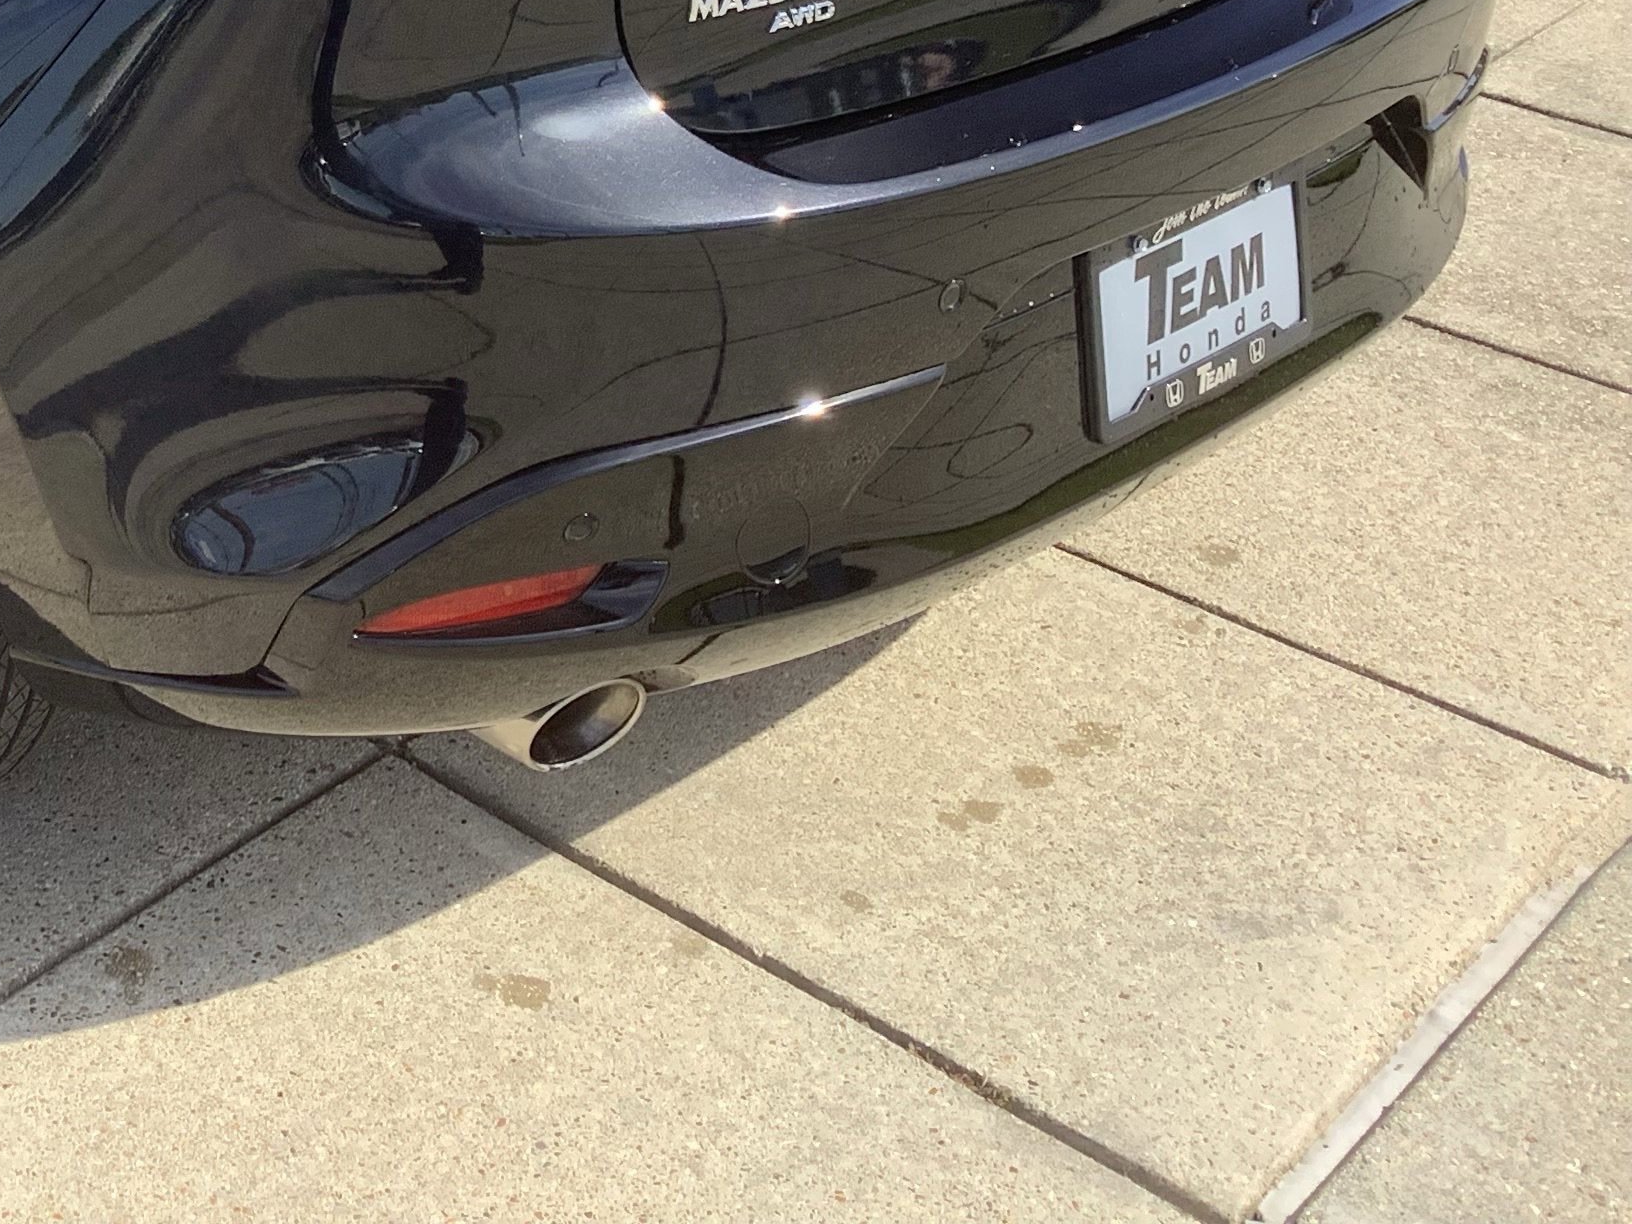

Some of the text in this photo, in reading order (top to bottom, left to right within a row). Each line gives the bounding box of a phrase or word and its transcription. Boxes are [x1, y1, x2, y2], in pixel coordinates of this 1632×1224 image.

[769, 0, 836, 33] AWD
[1134, 232, 1265, 346] TEAM
[1146, 300, 1271, 381] Honda
